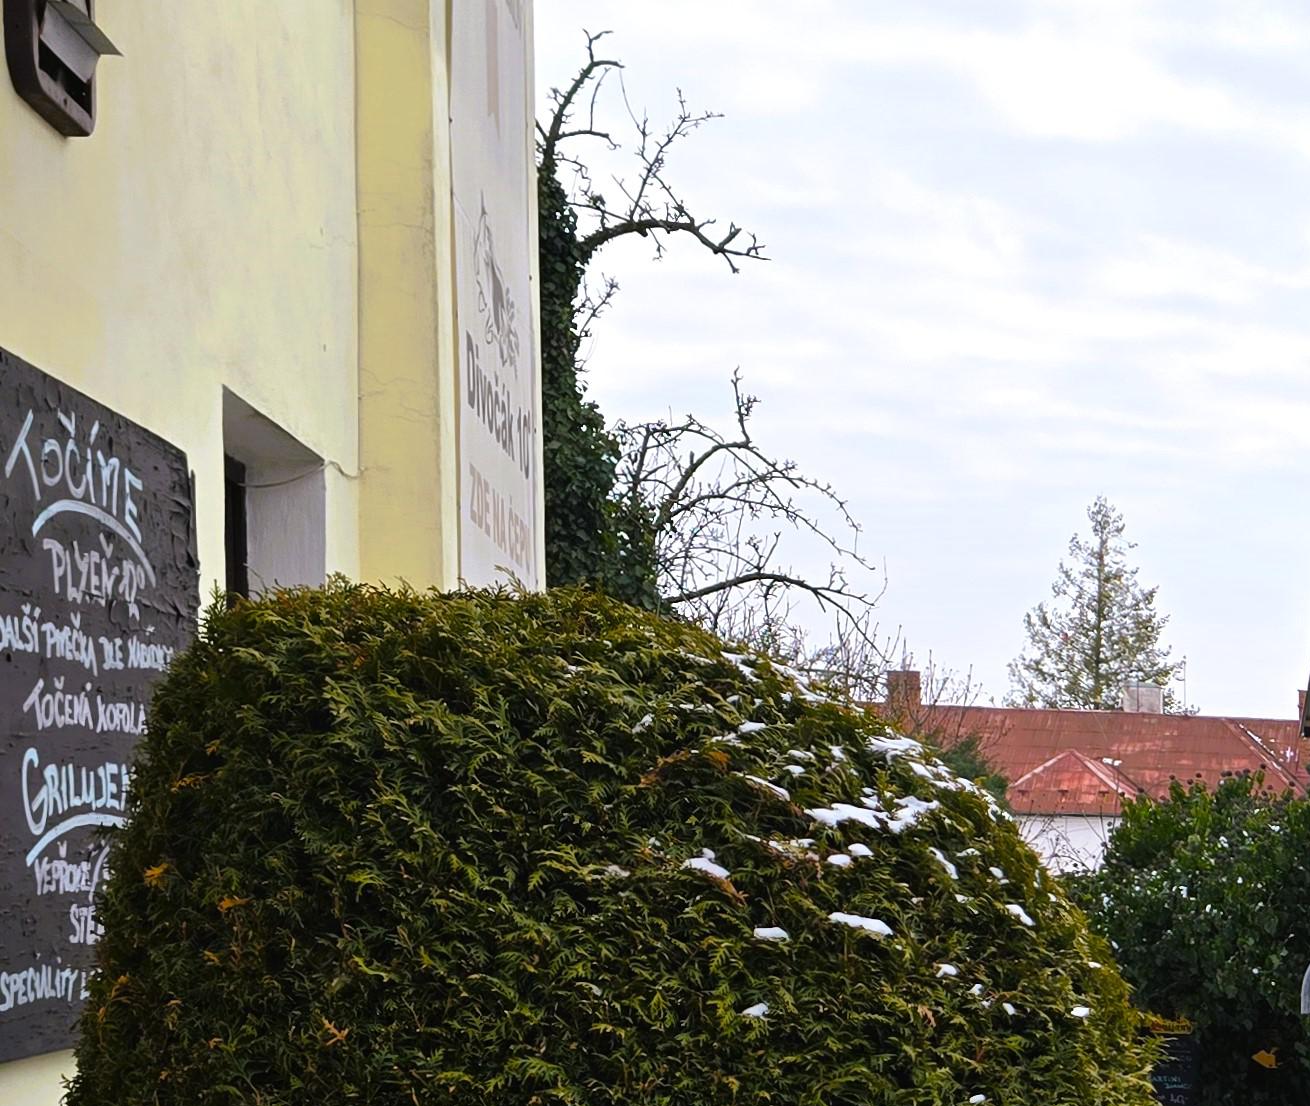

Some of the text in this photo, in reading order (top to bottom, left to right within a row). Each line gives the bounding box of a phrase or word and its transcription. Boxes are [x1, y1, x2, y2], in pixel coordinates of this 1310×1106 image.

[466, 330, 515, 461] Divočák
[5, 408, 144, 544] TOČÍME
[469, 462, 490, 538] ZDE
[492, 488, 507, 553] NA
[23, 676, 149, 736] TOČENÁ KOFOLA
